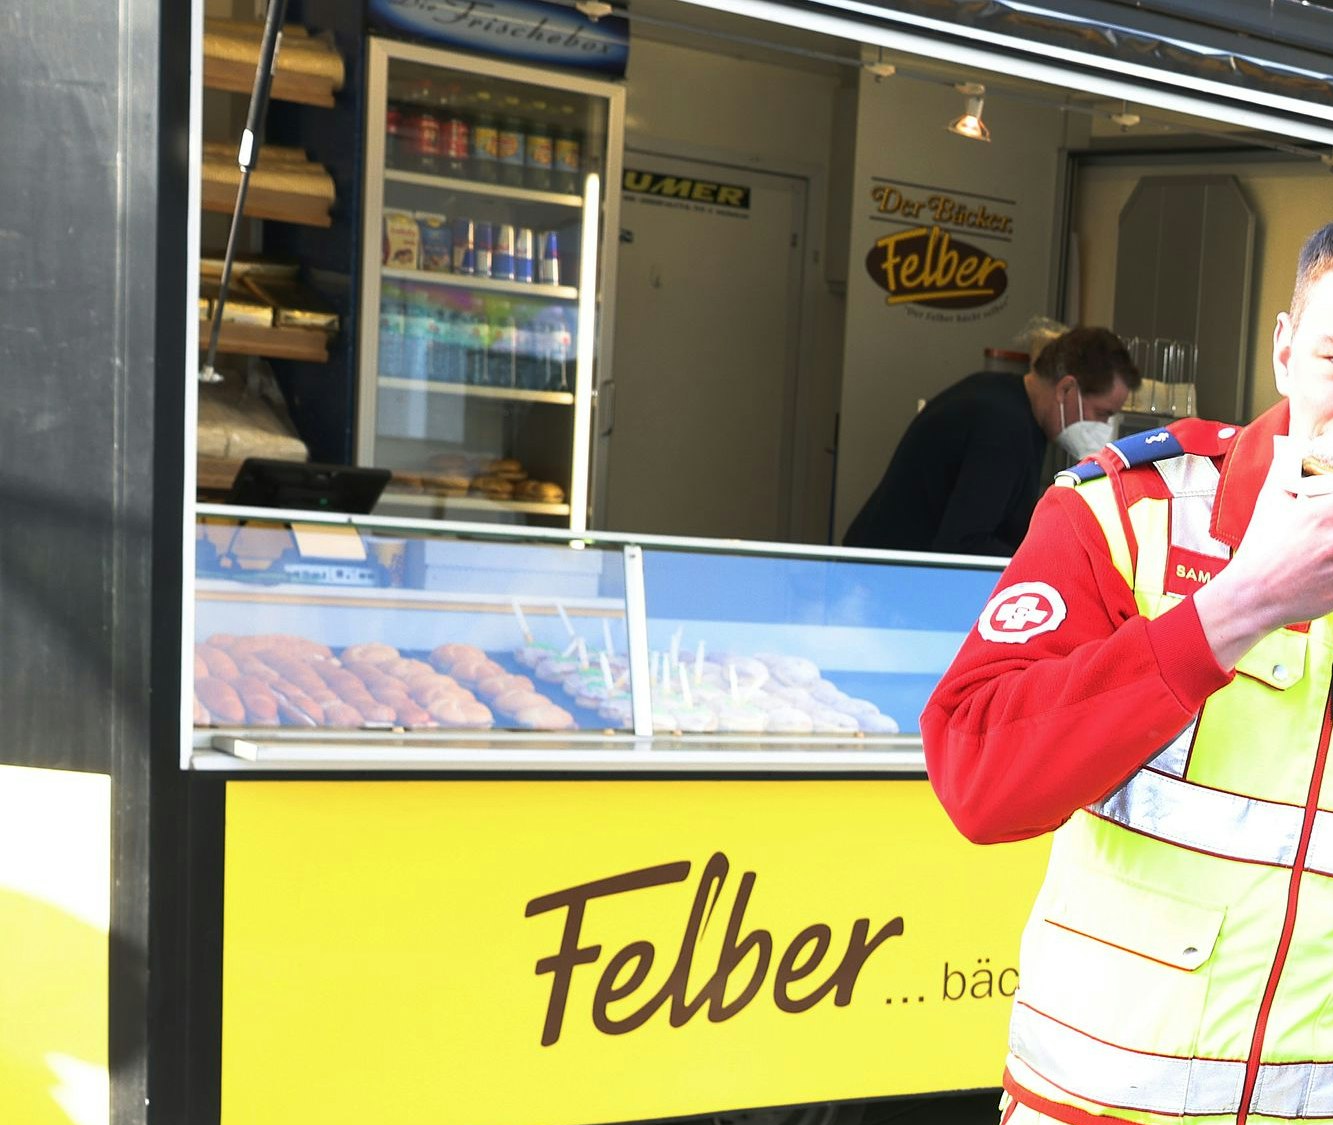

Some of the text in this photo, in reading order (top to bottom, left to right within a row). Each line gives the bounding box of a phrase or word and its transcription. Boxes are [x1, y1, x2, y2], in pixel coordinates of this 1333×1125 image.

[872, 185, 926, 218] Der
[876, 225, 1008, 291] Felber
[525, 852, 904, 1046] Felber
